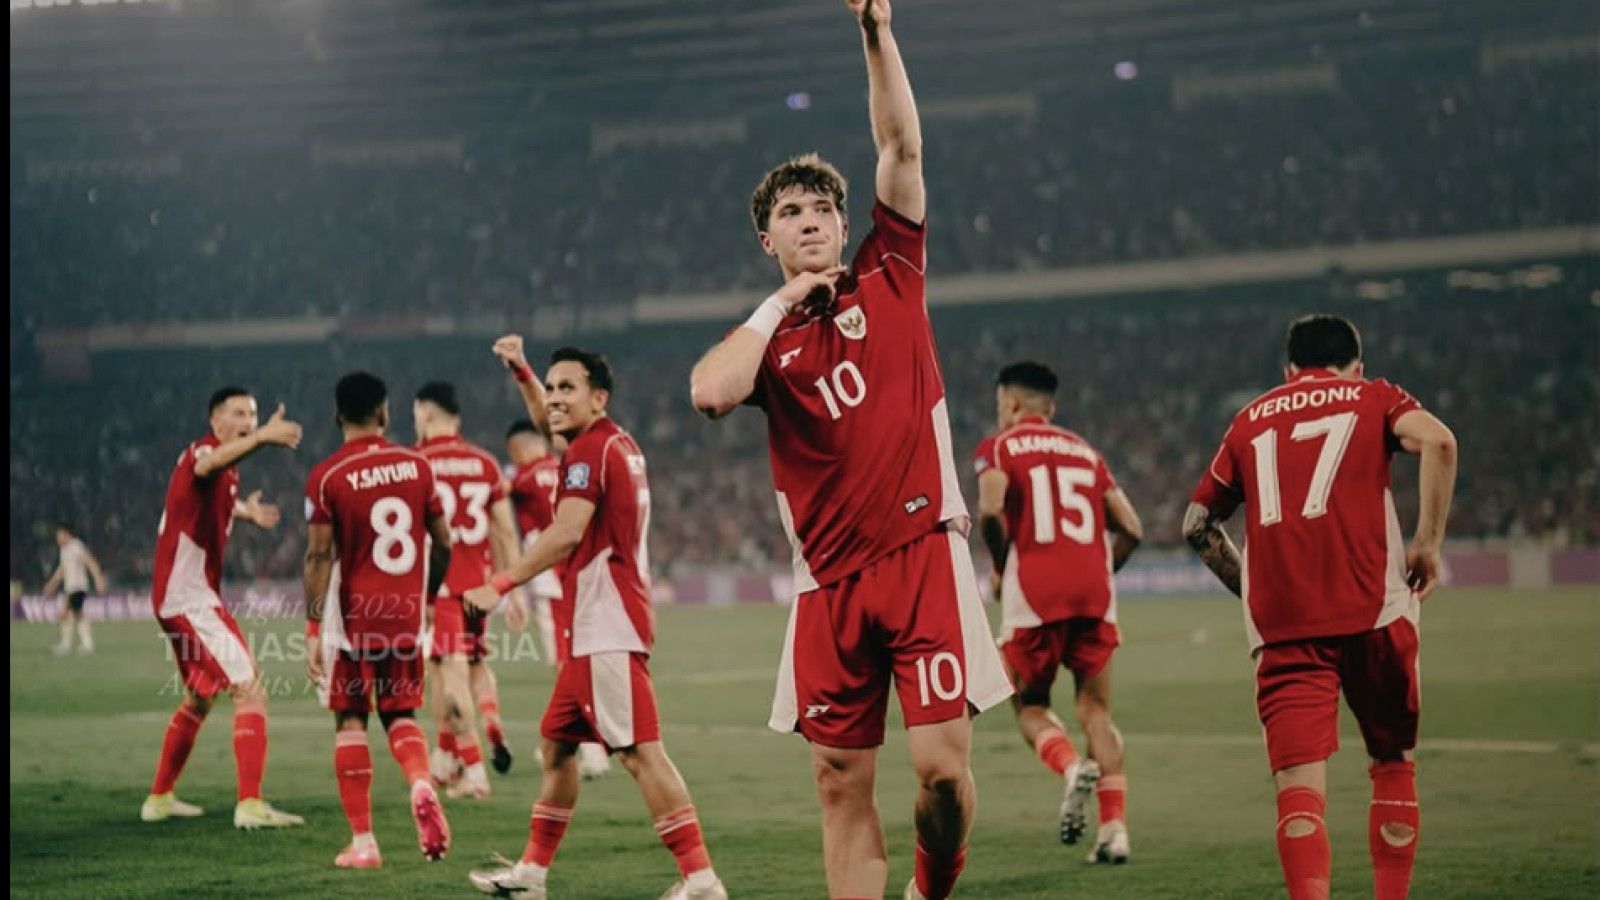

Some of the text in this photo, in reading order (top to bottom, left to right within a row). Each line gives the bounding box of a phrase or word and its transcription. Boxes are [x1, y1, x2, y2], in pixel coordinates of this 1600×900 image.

[815, 361, 866, 420] 10
[1249, 385, 1362, 421] VERDONK
[346, 460, 418, 491] Y.SAYURI
[1251, 411, 1358, 527] 17
[433, 481, 492, 544] 23
[1029, 465, 1095, 543] 15
[369, 497, 417, 576] 8
[915, 652, 963, 707] 10
